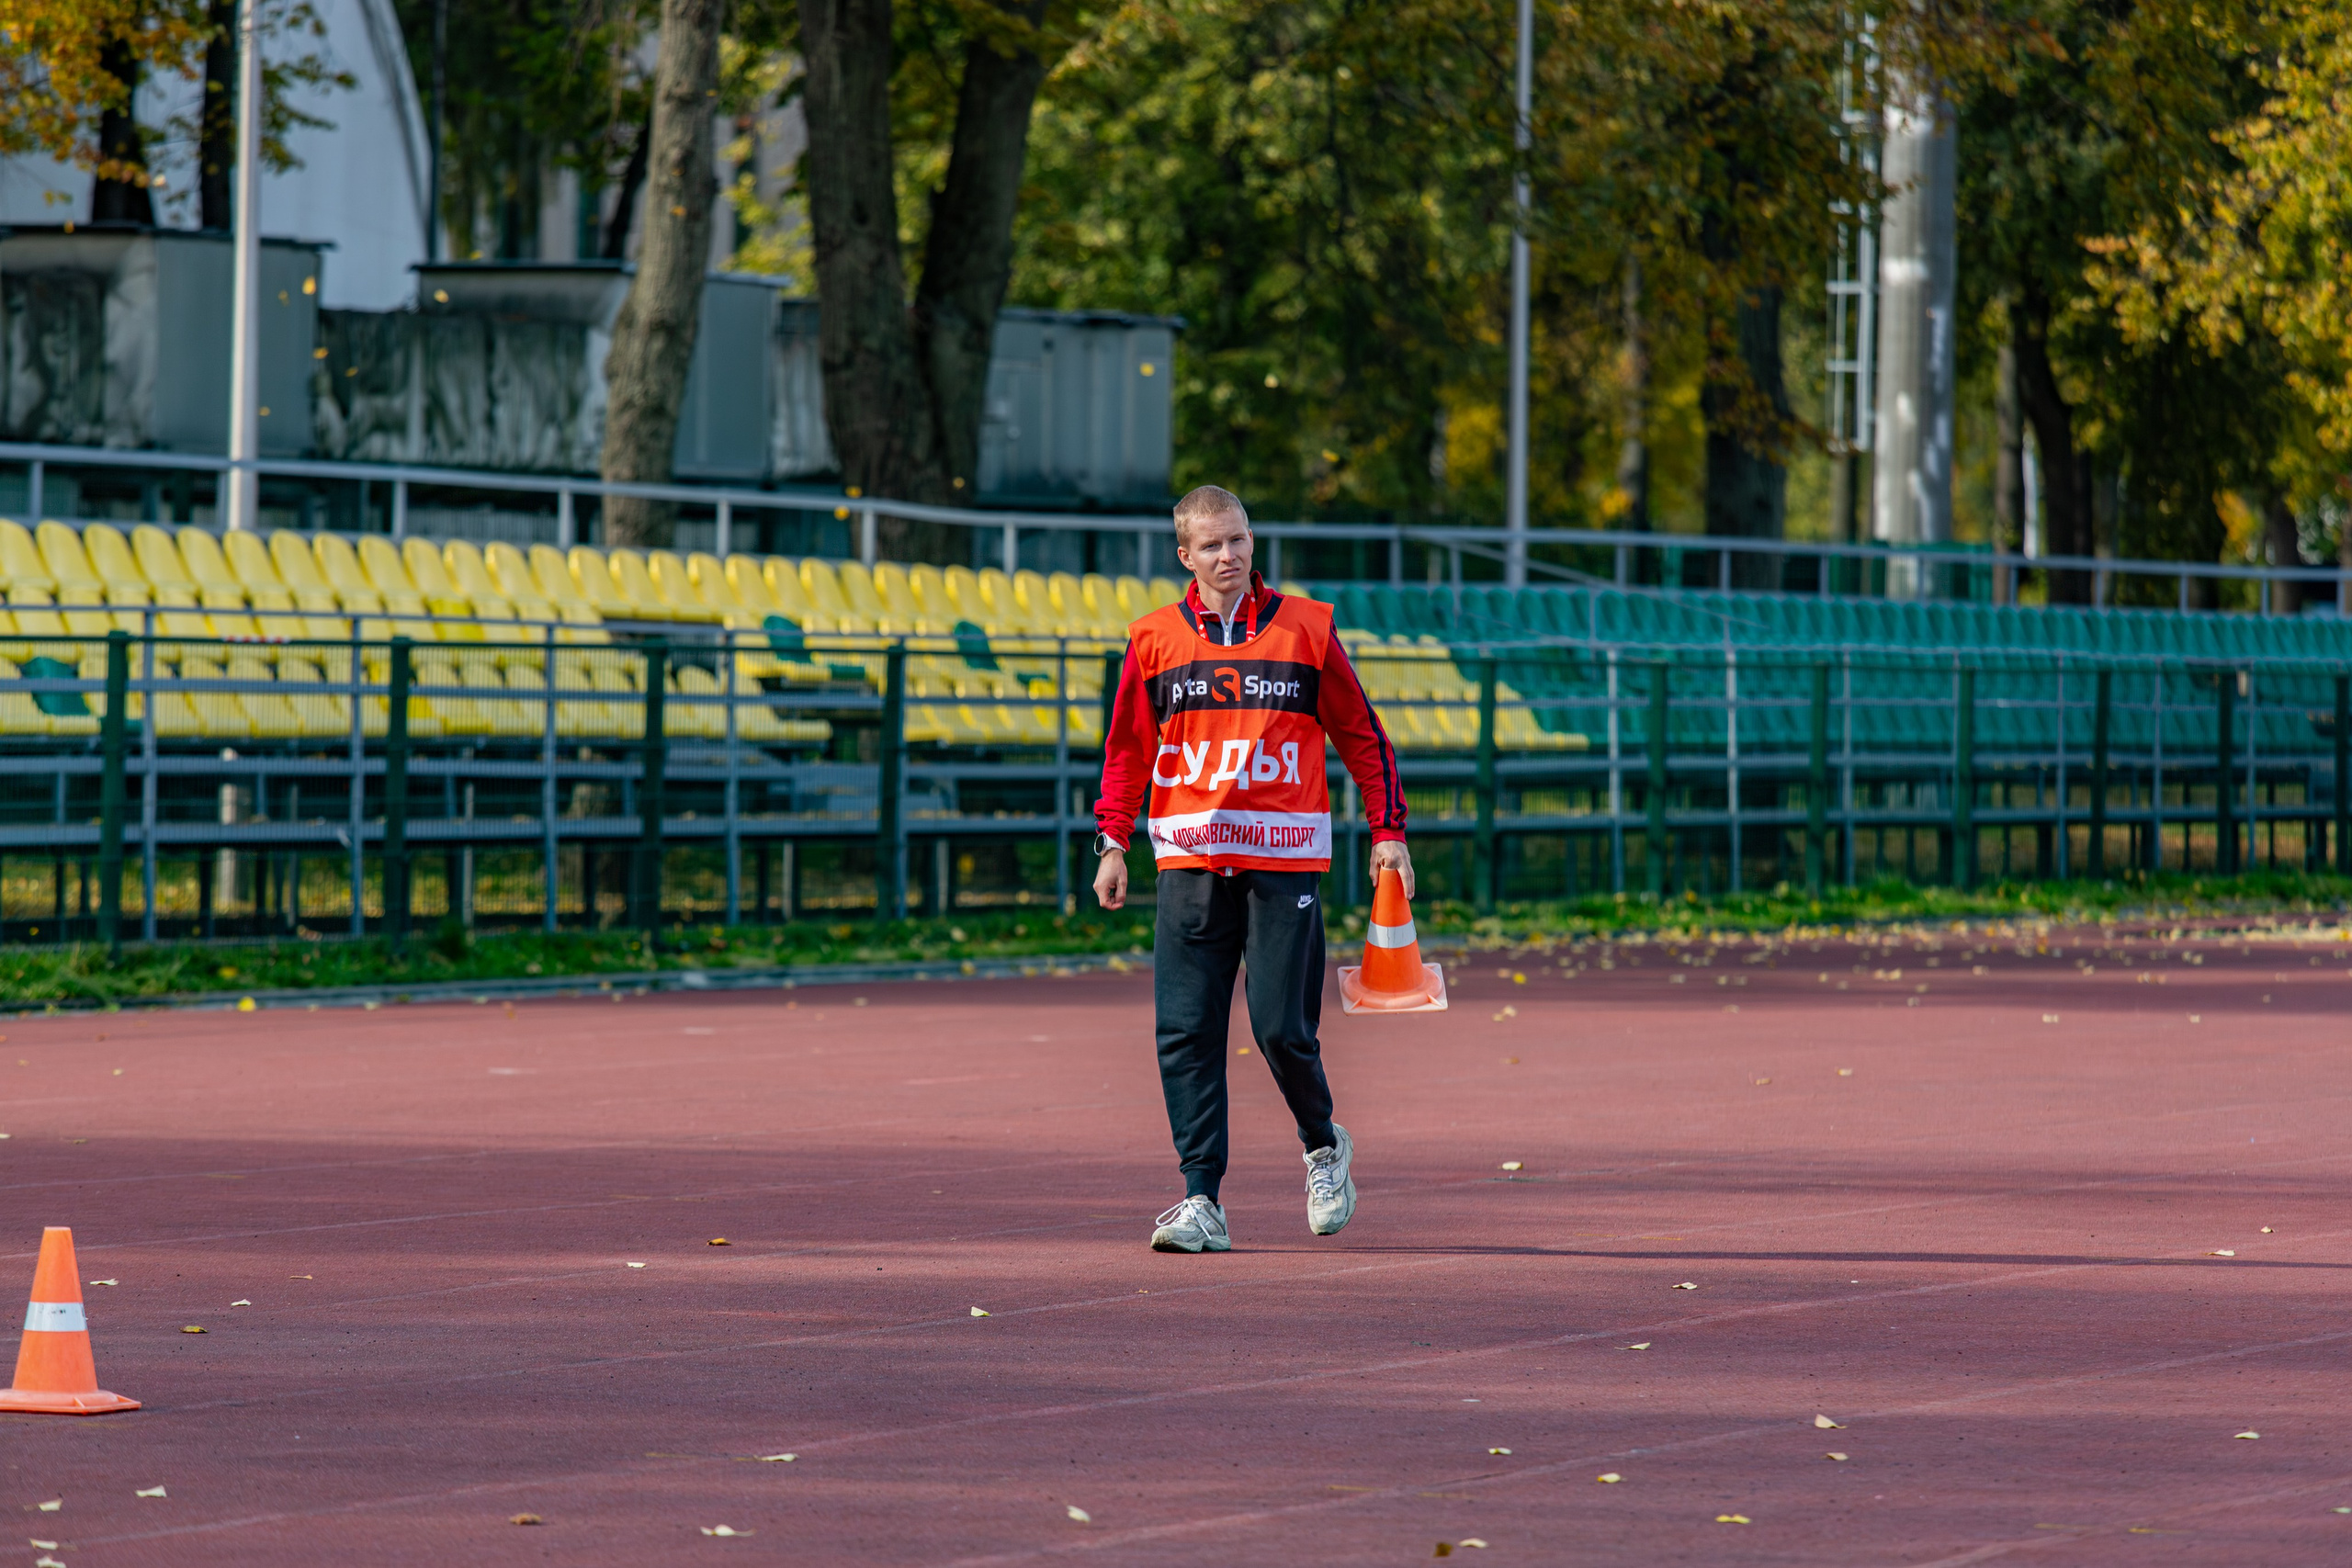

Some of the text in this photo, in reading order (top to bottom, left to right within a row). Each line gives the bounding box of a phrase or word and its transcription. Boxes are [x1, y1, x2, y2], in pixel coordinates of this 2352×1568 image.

[1172, 674, 1300, 705] Ata Sport
[1152, 739, 1302, 791] СУДЬЯ
[1172, 820, 1316, 850] МОСКОВСКИЙ СПОРТ
